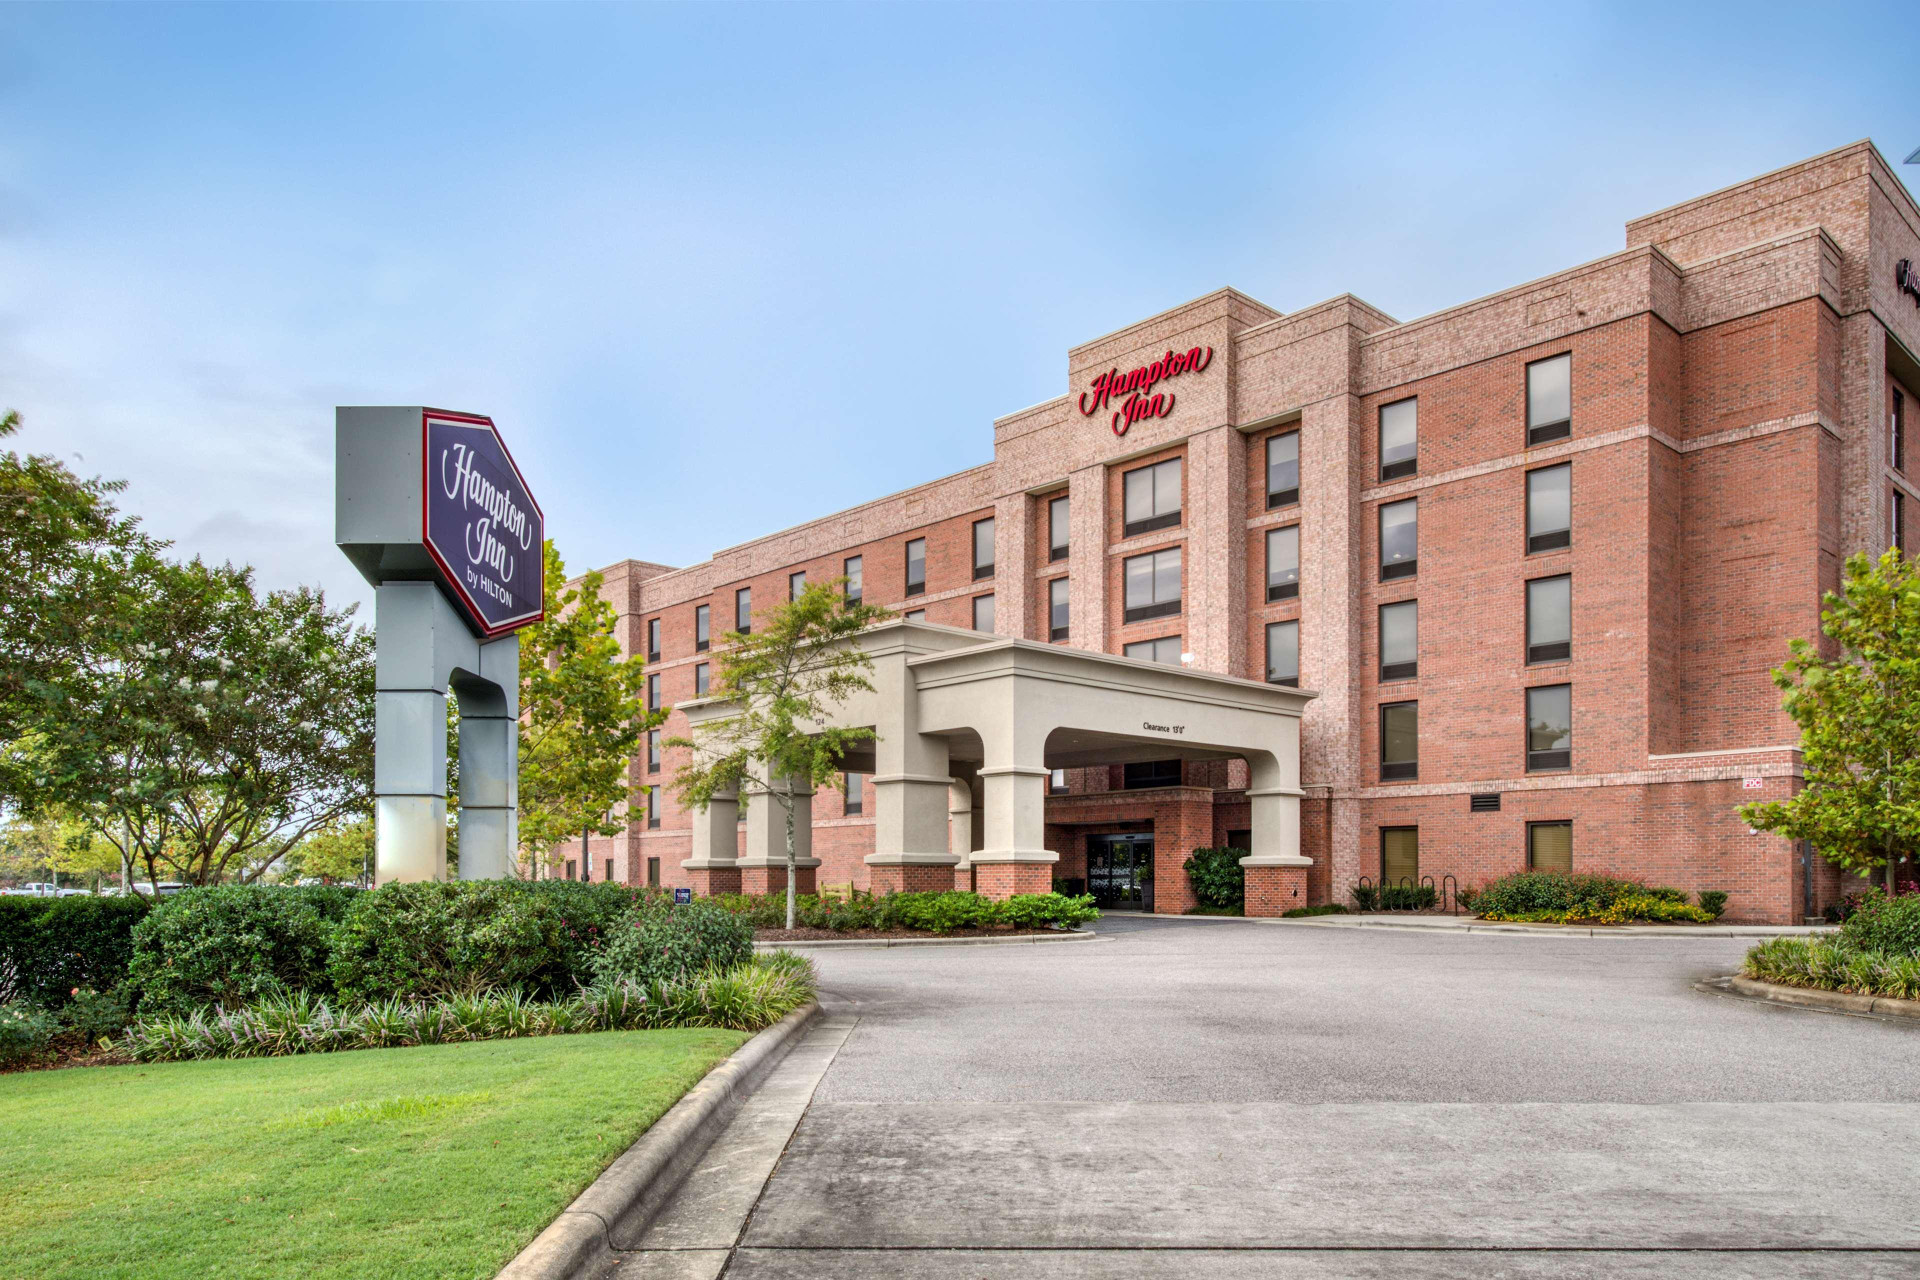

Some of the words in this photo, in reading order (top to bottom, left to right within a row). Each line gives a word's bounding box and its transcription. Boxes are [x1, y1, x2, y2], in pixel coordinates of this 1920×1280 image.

[1079, 346, 1212, 417] Hampton
[1111, 392, 1175, 436] Inn
[442, 443, 531, 550] Hampton
[466, 517, 514, 582] Inn
[467, 565, 478, 588] by
[480, 574, 512, 608] HILTON
[815, 718, 825, 726] 124
[1143, 722, 1170, 733] Clearance
[1744, 779, 1761, 787] FDC
